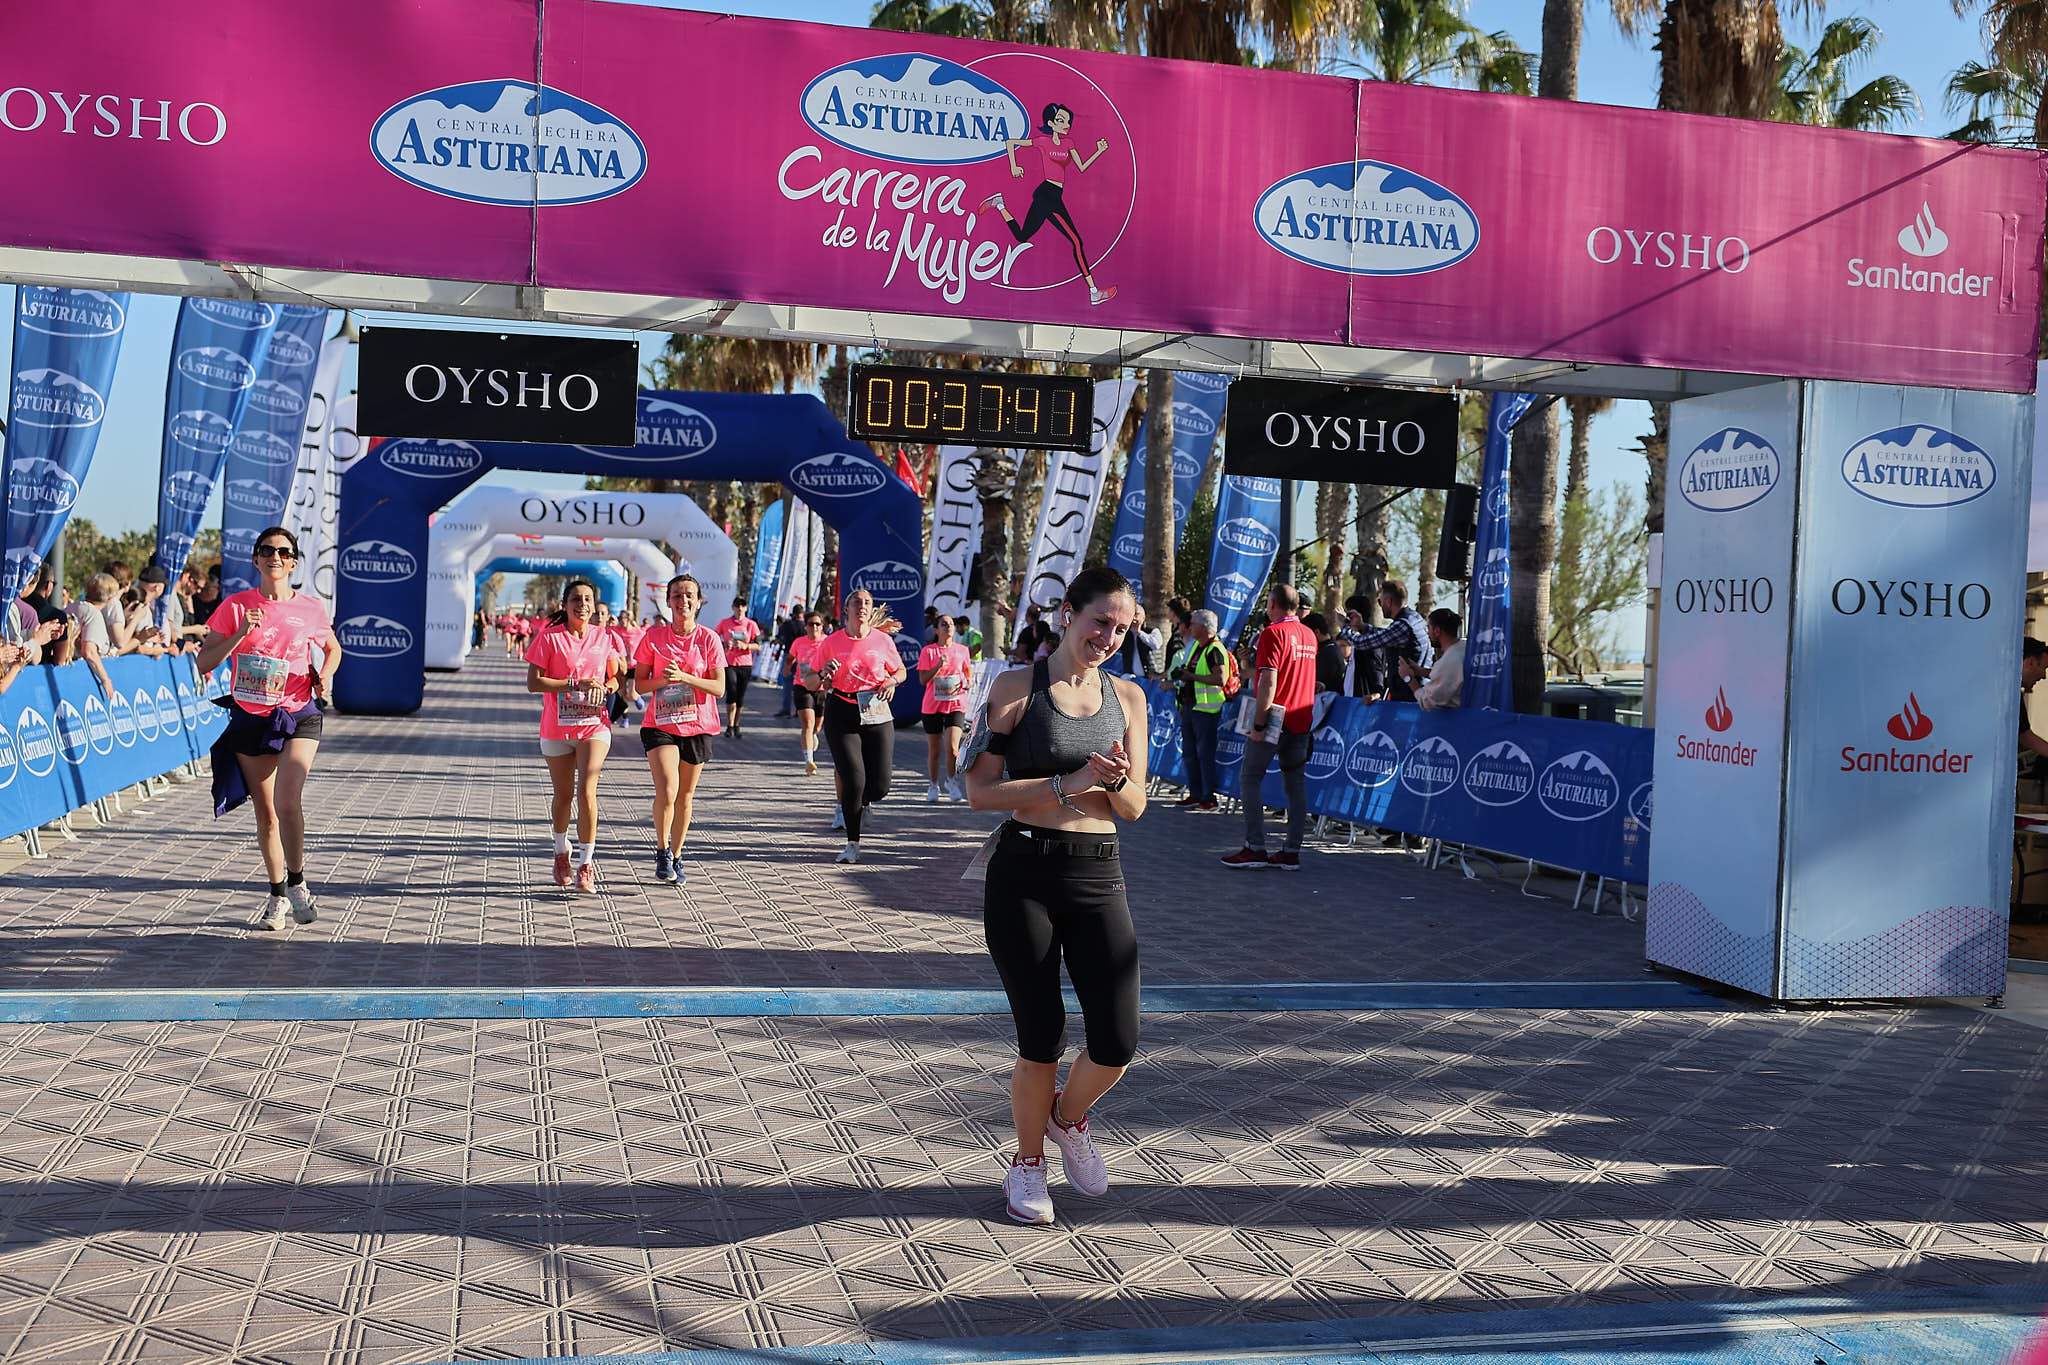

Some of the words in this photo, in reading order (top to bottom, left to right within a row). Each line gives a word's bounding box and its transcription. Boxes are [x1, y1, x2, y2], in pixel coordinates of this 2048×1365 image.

[818, 85, 1010, 142] ASTURIANA
[856, 86, 927, 102] CENTRAL
[935, 94, 1006, 110] LECHERA
[0, 86, 228, 146] OYSHO
[437, 118, 523, 136] CENTRAL
[532, 127, 618, 143] LECHERA
[778, 146, 967, 216] Carrera
[1308, 196, 1378, 211] CENTRAL
[1386, 202, 1456, 217] LECHERA
[823, 209, 858, 248] de
[865, 210, 891, 251] la
[883, 212, 1034, 304] Mujer
[1587, 226, 1750, 274] OYSHO
[1848, 258, 1993, 297] Santander
[405, 364, 599, 412] OYSHO
[14, 393, 94, 421] STURIANA
[637, 426, 704, 447] RIANA
[1265, 412, 1425, 456] OYSHO
[1700, 456, 1732, 468] CENTRAL
[1735, 451, 1770, 464] LECHERA
[1852, 453, 1984, 490] ASTURIANA
[1877, 450, 1926, 463] CENTRAL
[1930, 454, 1981, 465] LECHERA
[1686, 462, 1771, 494] ASTURIANA
[521, 498, 645, 527] OYSHO
[1676, 577, 1774, 614] OYSHO
[1832, 578, 1992, 619] OYSHO
[1677, 735, 1758, 767] Santander
[1841, 747, 1973, 773] Santander
